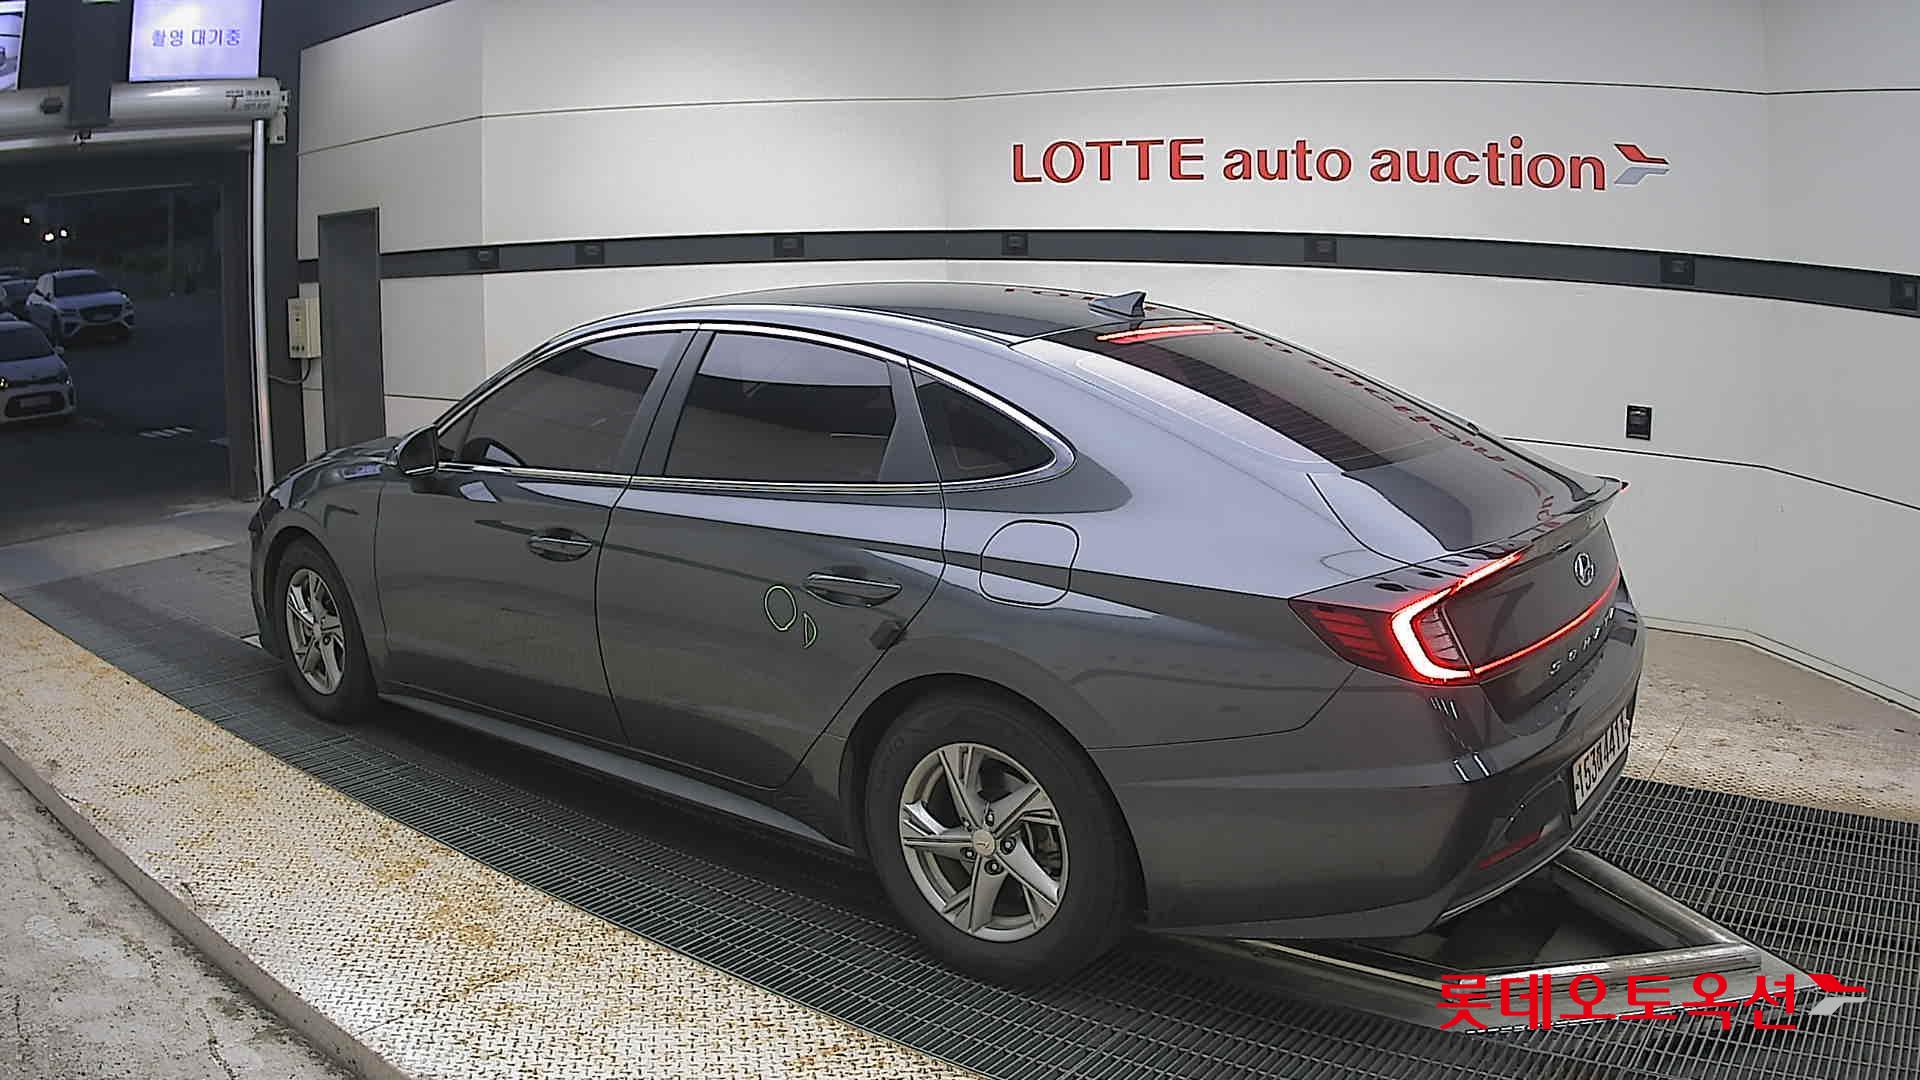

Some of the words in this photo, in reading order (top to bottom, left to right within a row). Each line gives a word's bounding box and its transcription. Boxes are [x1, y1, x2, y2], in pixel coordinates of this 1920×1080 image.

[191, 28, 241, 47] 대기중
[1012, 138, 1204, 184] LOTTE
[1222, 139, 1353, 183] auto
[1369, 135, 1607, 190] auction
